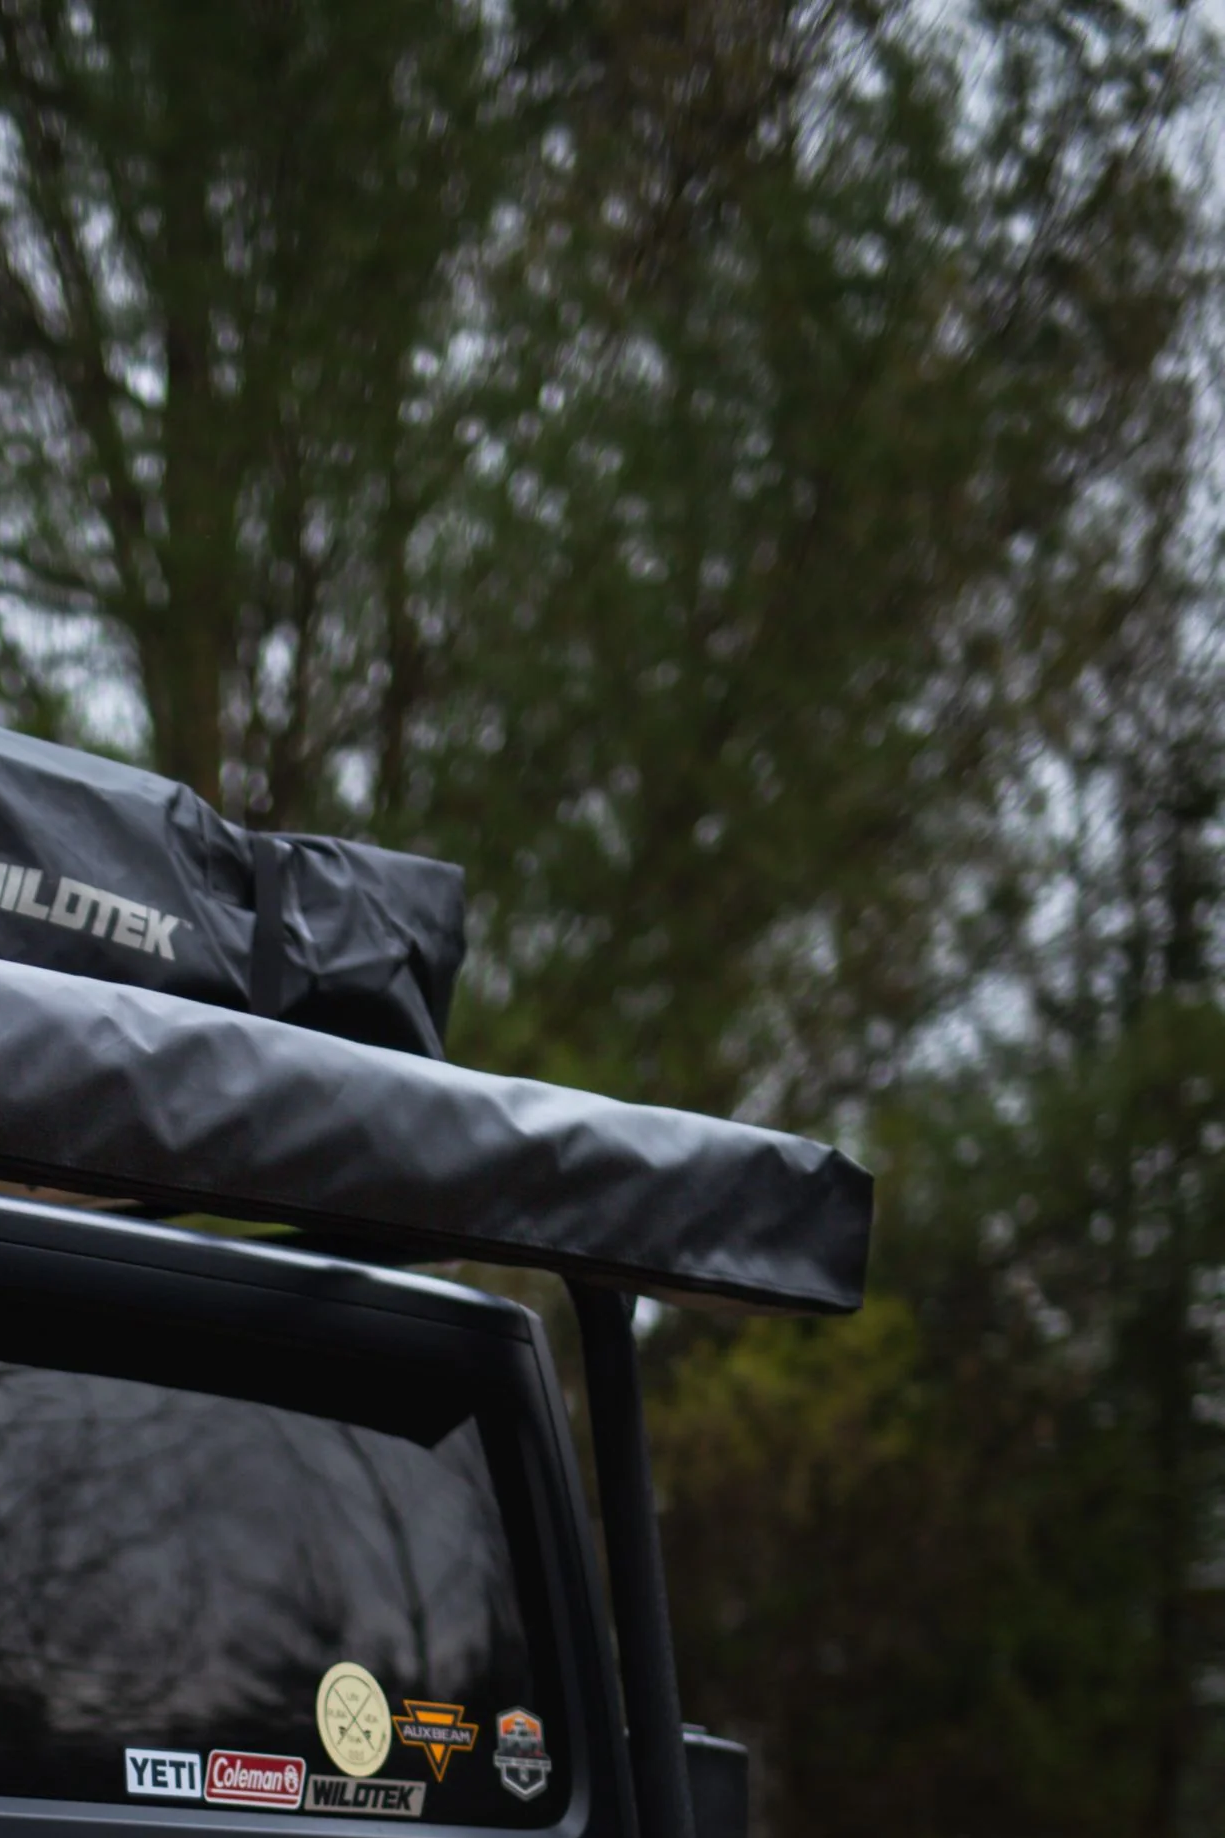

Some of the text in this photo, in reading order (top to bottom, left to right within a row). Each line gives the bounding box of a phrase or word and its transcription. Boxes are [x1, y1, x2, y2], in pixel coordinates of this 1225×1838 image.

[403, 1724, 470, 1743] AUXBEAM
[129, 1757, 196, 1790] YETI
[212, 1758, 283, 1792] Coleman
[312, 1779, 417, 1812] WILDTEK
